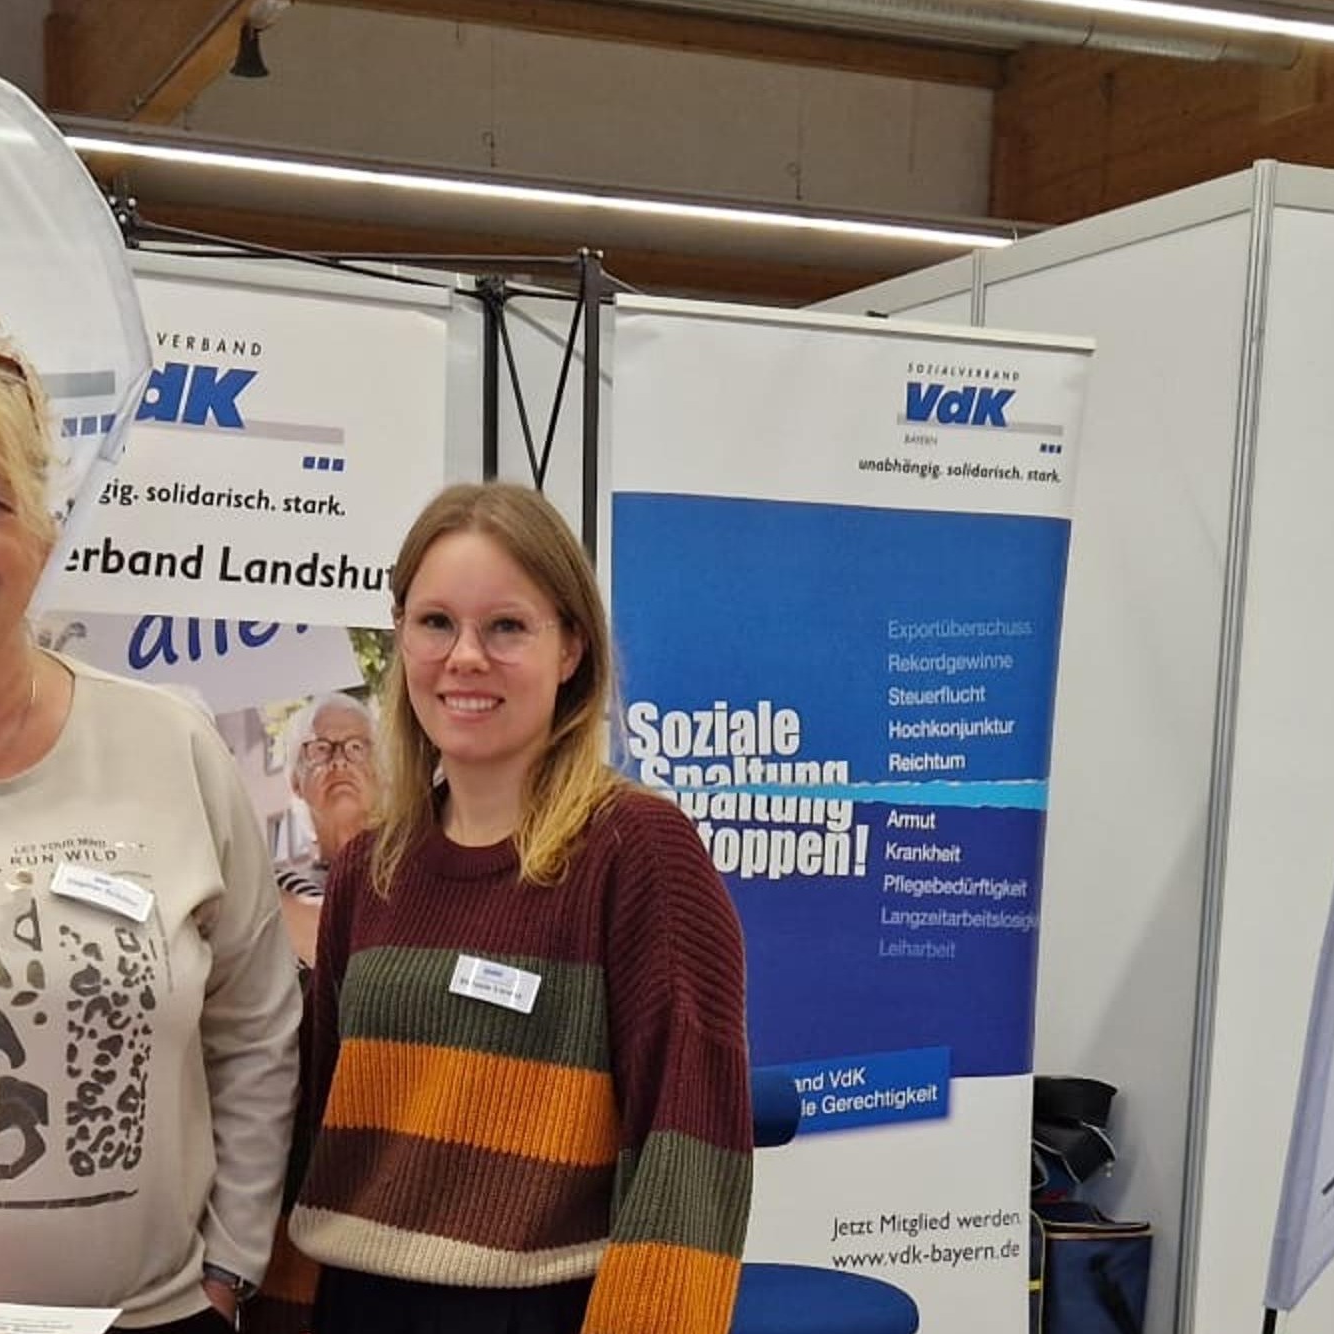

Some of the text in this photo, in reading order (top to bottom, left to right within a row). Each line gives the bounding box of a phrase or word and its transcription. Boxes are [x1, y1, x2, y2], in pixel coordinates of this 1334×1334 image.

[908, 363, 1019, 382] SOZIALVERBAND
[906, 381, 1016, 428] VdK
[858, 458, 1061, 484] unabhängig. solidarisch. stark.
[147, 479, 276, 512] solidarisch.
[282, 493, 346, 517] stark.
[888, 619, 1033, 642] Exportüberschuss
[888, 653, 1014, 675] Rekordgewinne
[888, 685, 986, 706] Steuerflucht
[628, 701, 800, 759] Soziale
[888, 717, 1015, 740] Hochkonjunktur
[888, 753, 966, 772] Reichtum
[886, 809, 936, 830] Armut
[11, 850, 117, 865] RUN WILD
[884, 841, 961, 863] Krankheit
[883, 874, 1027, 899] Pflegebedürftigkeit
[879, 937, 956, 959] Leiharbeit
[829, 1067, 866, 1088] VdK
[822, 1084, 938, 1114] Gerechtigkeit
[831, 1209, 1020, 1242] Jetzt Mitglied werden
[832, 1240, 1020, 1268] www.vdk-bayern.de
